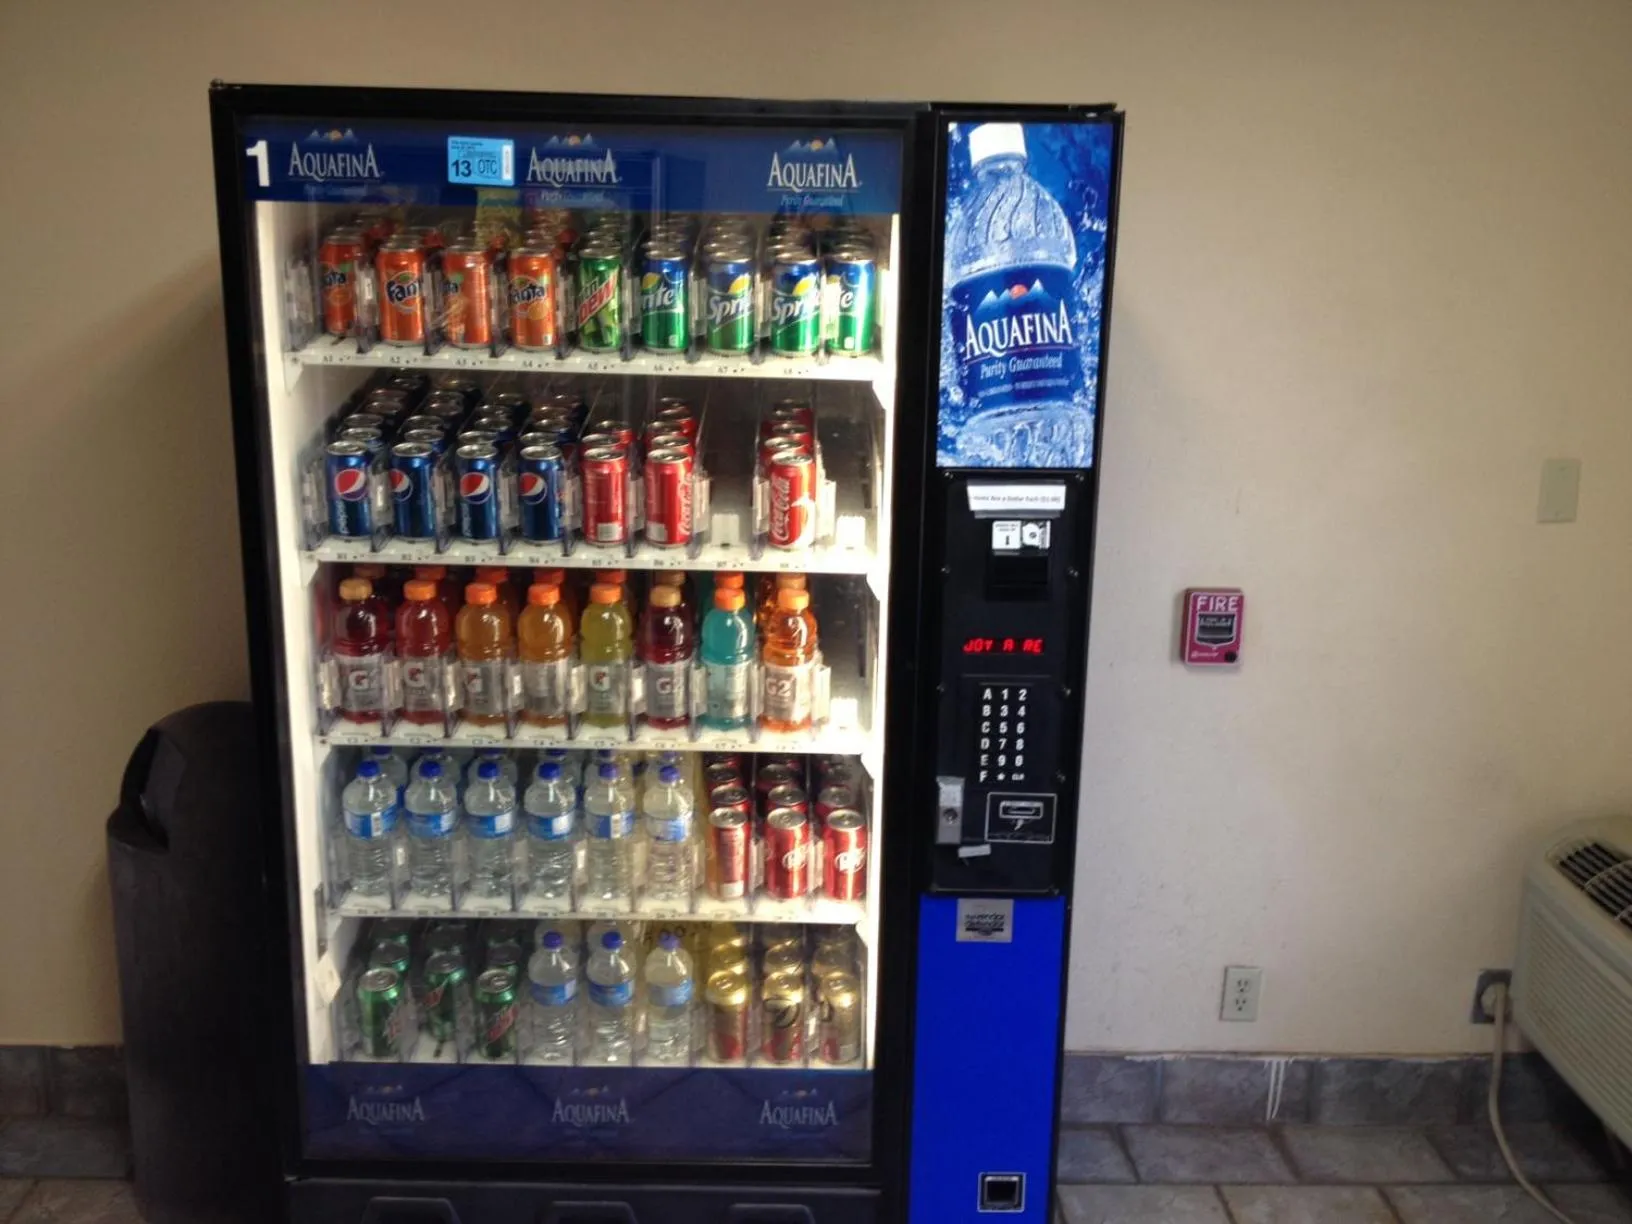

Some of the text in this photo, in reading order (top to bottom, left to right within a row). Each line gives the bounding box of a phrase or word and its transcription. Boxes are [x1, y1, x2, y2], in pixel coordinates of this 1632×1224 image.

[245, 140, 270, 187] 1
[288, 141, 380, 182] AQUAFINA
[451, 160, 472, 177] 13
[478, 159, 498, 176] OTC
[527, 146, 617, 187] AQUAFINA
[767, 151, 857, 192] AQUAFINA
[965, 298, 1073, 360] AQUAFINA
[980, 354, 1063, 380] Purity Guaranteed
[771, 473, 790, 541] Coca-Cola
[1197, 595, 1240, 612] FIRE
[765, 676, 794, 697] G2
[983, 688, 1027, 701] A 1 2
[982, 704, 1026, 717] B 3 4
[981, 721, 1025, 734] C 5 6
[981, 737, 1024, 751] D 7 8
[980, 754, 989, 766] E
[998, 754, 1006, 767] 9
[980, 770, 988, 783] F
[346, 1094, 425, 1126] AQUAFINA
[551, 1096, 630, 1128] AQUAFINA
[759, 1099, 839, 1130] AQUAFINA
